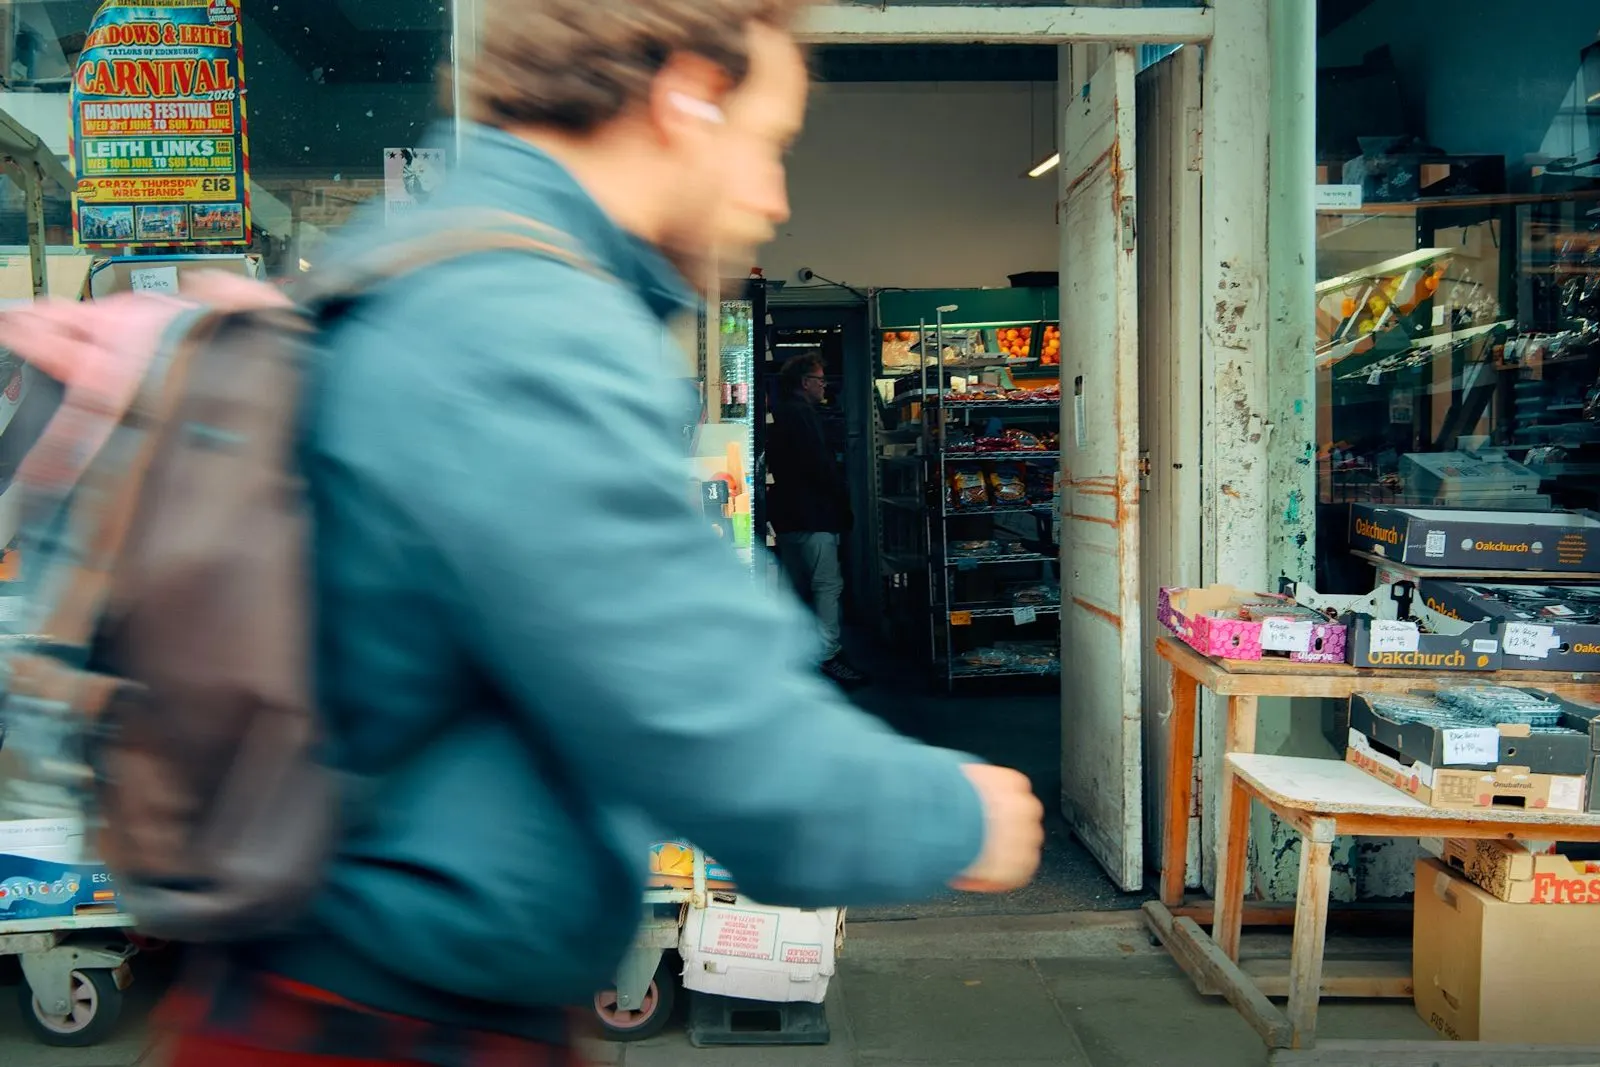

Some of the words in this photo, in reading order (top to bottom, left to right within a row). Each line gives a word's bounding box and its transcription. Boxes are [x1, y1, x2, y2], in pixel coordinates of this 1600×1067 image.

[163, 24, 177, 45] &
[180, 25, 232, 47] LEITH
[77, 59, 235, 97] CARNIVAL
[207, 90, 235, 101] 2026
[84, 103, 153, 120] MEADOWS
[154, 102, 214, 119] FESTIVAL
[86, 120, 108, 131] WED
[130, 120, 153, 130] JUNE
[154, 120, 168, 129] TO
[169, 120, 189, 129] SUN
[208, 119, 231, 129] JUNE
[85, 142, 145, 157] LEITH
[151, 141, 214, 156] LINKS
[88, 159, 108, 168] WED
[132, 158, 153, 168] JUNE
[154, 158, 167, 168] TO
[168, 158, 188, 168] SUN
[210, 157, 232, 167] JUNE
[98, 180, 136, 188] CRAZY
[140, 180, 198, 188] THURSDAY
[202, 178, 231, 192] £18
[112, 188, 185, 197] WRISTBANDS
[1355, 518, 1398, 544] Oakchurch
[1475, 541, 1529, 553] Oakchurch
[1368, 649, 1465, 666] Oakchurch
